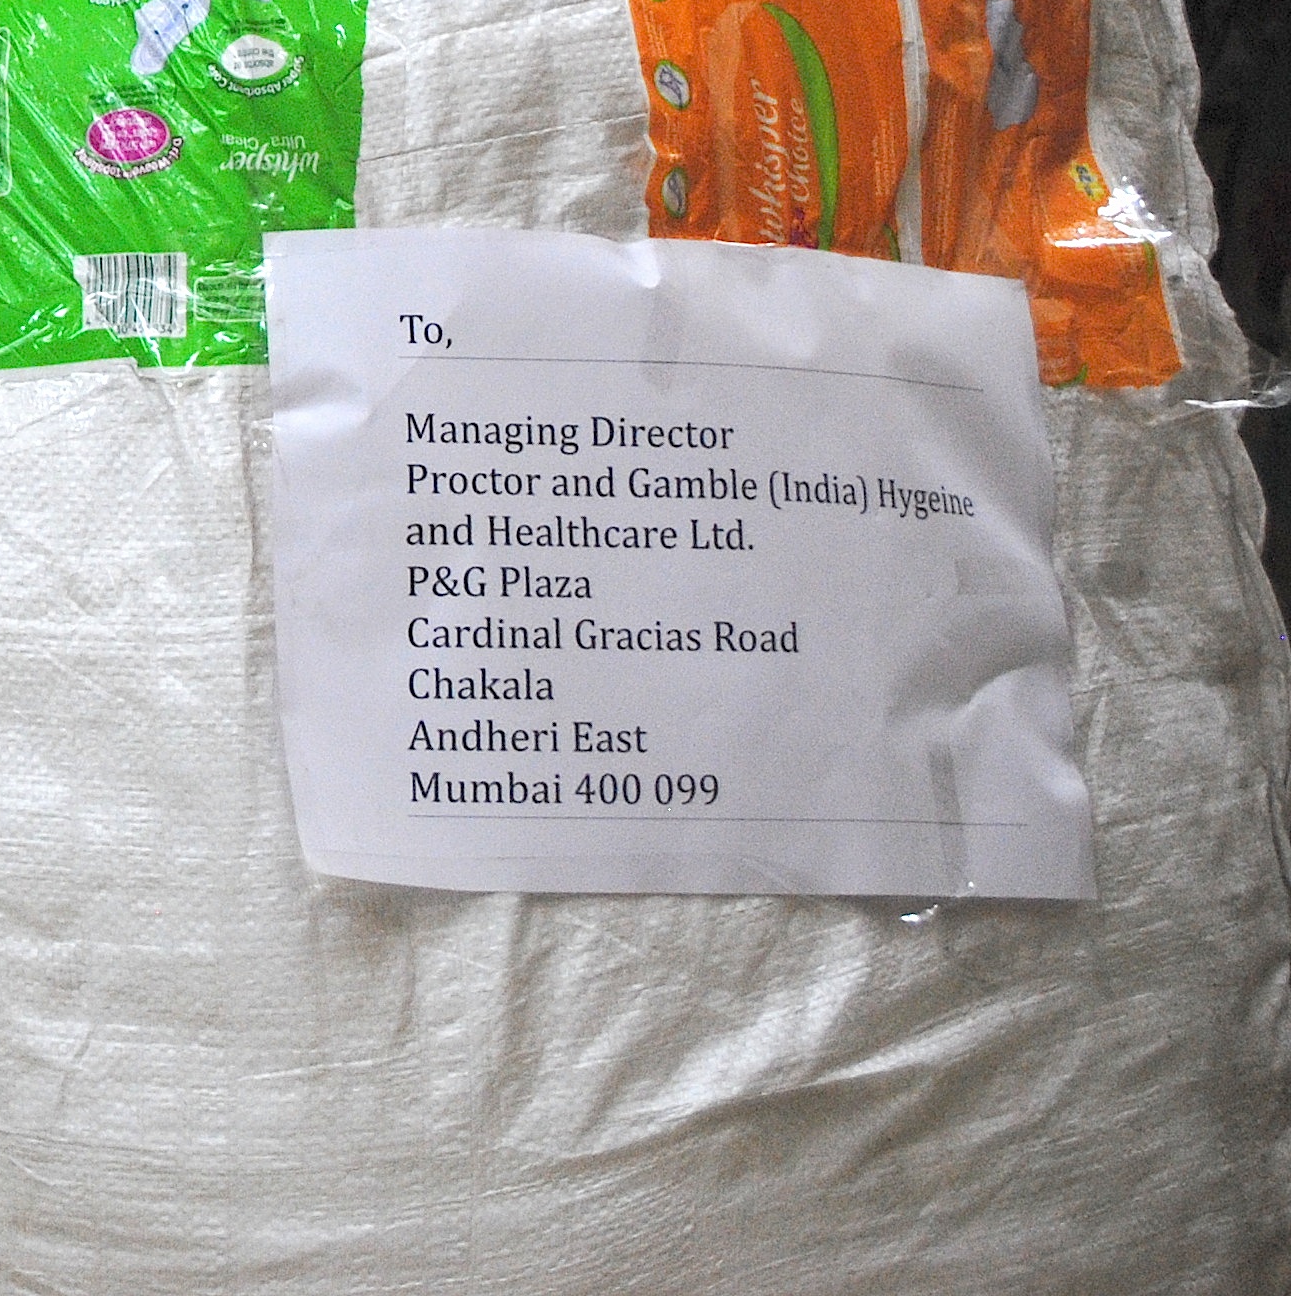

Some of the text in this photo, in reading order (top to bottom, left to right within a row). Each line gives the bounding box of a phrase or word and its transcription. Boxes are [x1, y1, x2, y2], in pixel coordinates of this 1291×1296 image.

[271, 134, 306, 150] Ultra
[748, 77, 788, 243] whisper
[786, 97, 810, 202] choice
[220, 143, 319, 183] whisper
[399, 314, 452, 349] To,
[406, 413, 734, 454] Managing Director
[408, 464, 974, 520] Proctor and Gamble (India) Hygeine
[406, 513, 754, 551] and Healthcare Ltd.
[409, 565, 592, 599] P&G Plaza
[407, 616, 799, 653] Cardinal Gracias Road
[408, 667, 554, 701] Chakala
[408, 719, 647, 754] Andheri East
[411, 771, 719, 806] Mumbai 400 099
